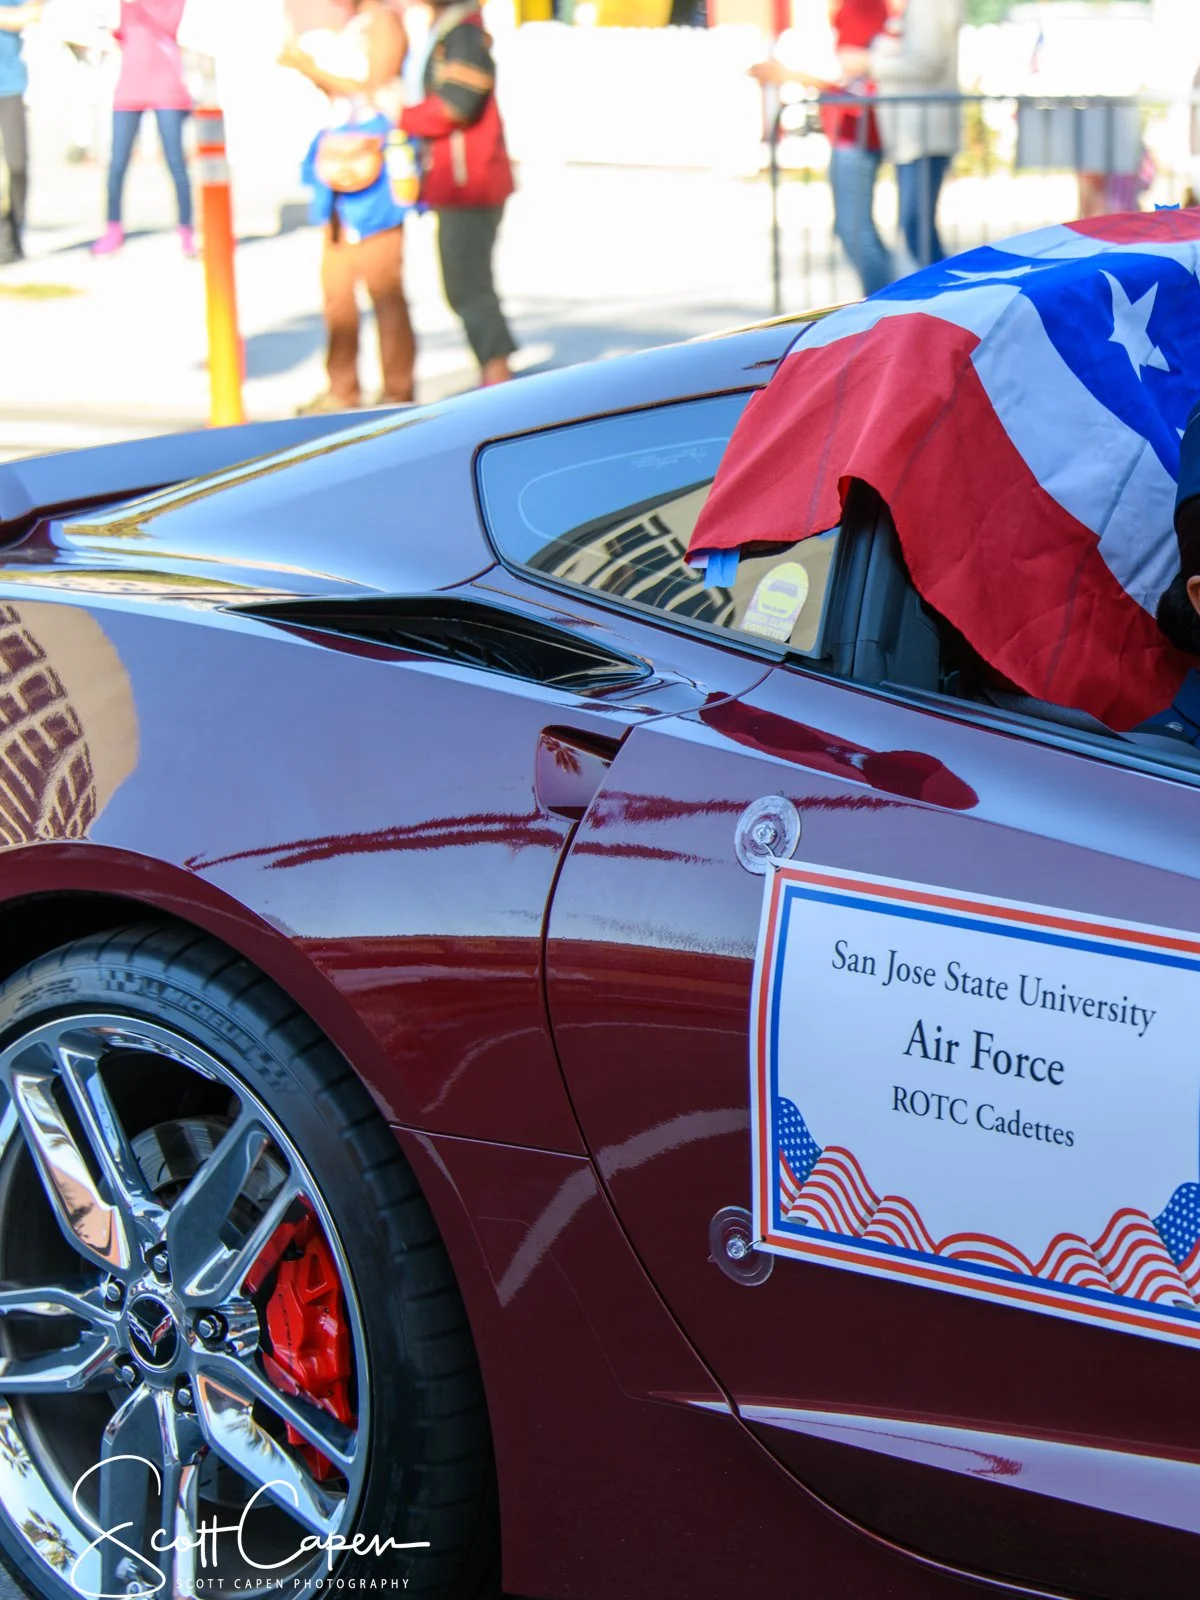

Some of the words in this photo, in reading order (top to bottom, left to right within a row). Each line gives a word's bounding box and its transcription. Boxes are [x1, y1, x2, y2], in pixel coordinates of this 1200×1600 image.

[832, 939, 876, 976] San
[882, 949, 936, 987] Jose
[945, 961, 1008, 1001] State
[1019, 974, 1156, 1037] University
[902, 1019, 960, 1065] Air
[970, 1030, 1065, 1086] Force
[892, 1085, 968, 1125] ROTC
[976, 1103, 1074, 1147] Cadettes
